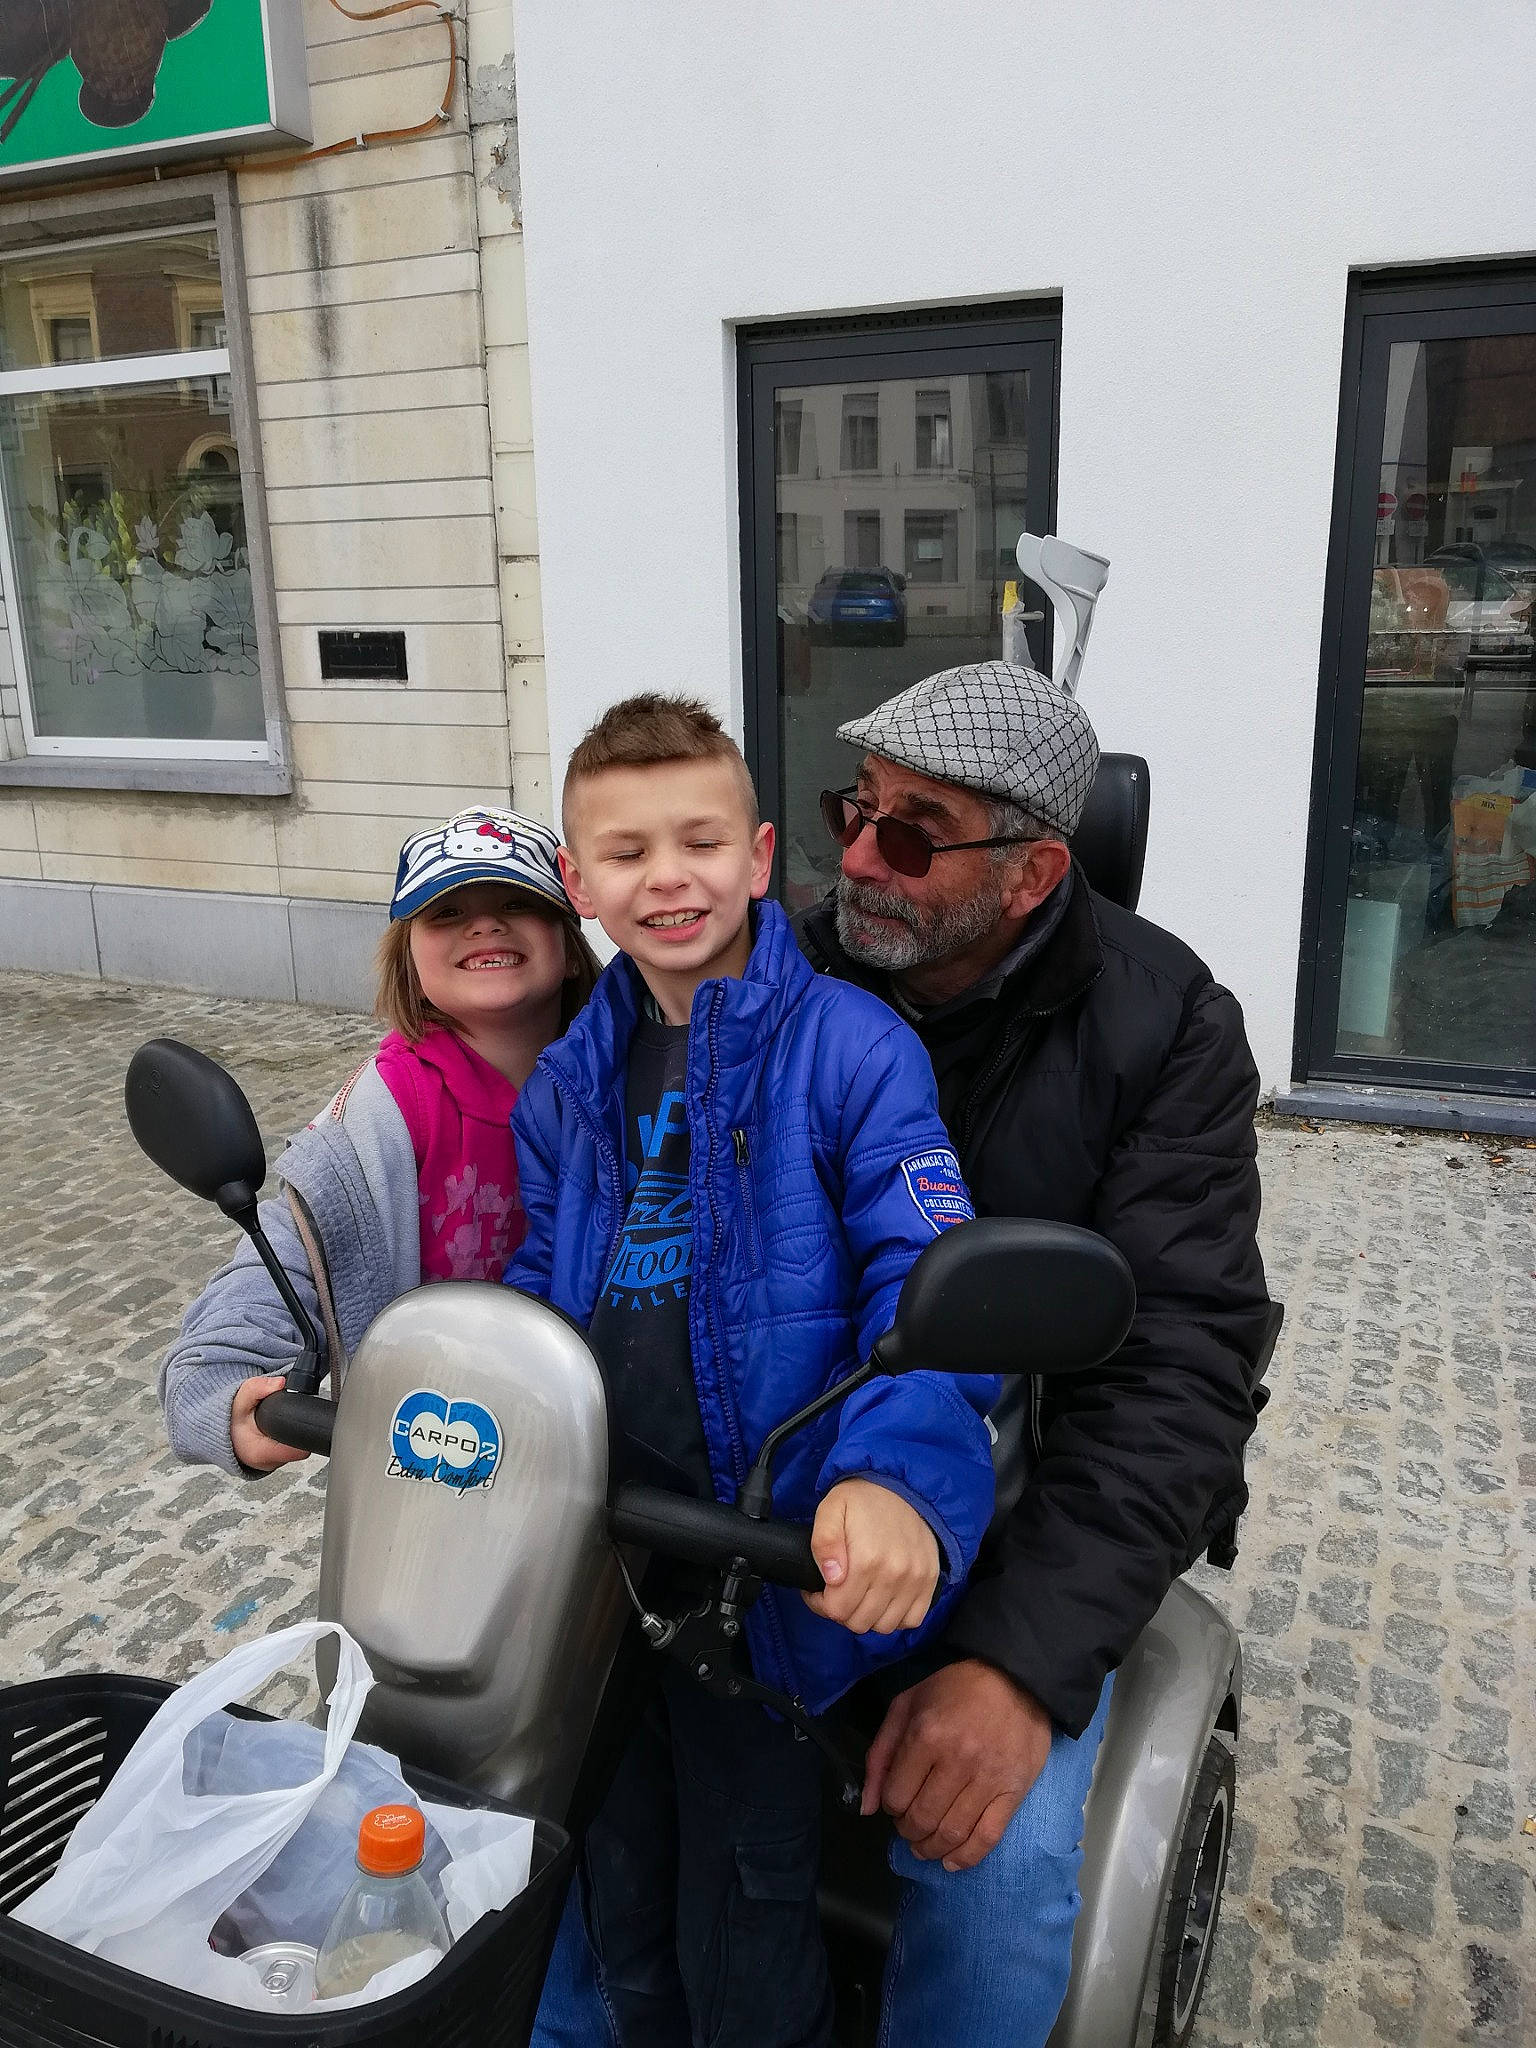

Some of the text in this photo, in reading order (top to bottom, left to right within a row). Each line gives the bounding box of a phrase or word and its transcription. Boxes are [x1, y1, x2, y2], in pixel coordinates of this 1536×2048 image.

[907, 1154, 945, 1173] ARKANSAS
[916, 1175, 957, 1193] Buena
[923, 1198, 966, 1212] COLLEGIATE
[387, 1454, 493, 1496] Extra Comfort
